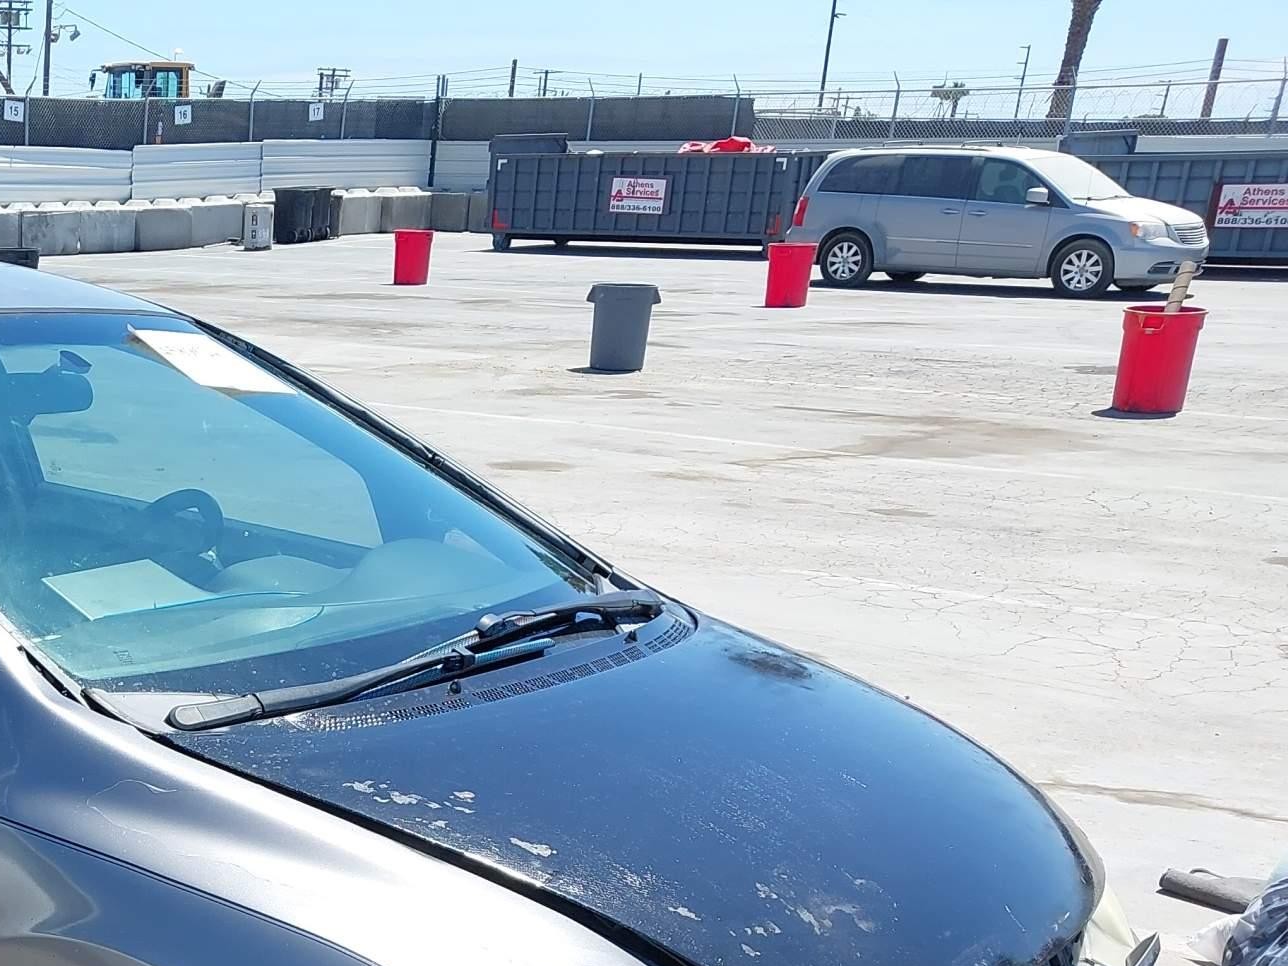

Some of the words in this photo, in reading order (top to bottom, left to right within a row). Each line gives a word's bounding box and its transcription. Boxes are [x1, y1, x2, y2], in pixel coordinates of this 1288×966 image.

[8, 105, 19, 117] 15
[178, 110, 188, 120] 16
[312, 107, 321, 117] 17
[626, 179, 654, 189] Athens
[1242, 187, 1286, 196] Athens
[610, 203, 661, 213] 888/336-6100
[1217, 217, 1288, 225] 888/336-610
